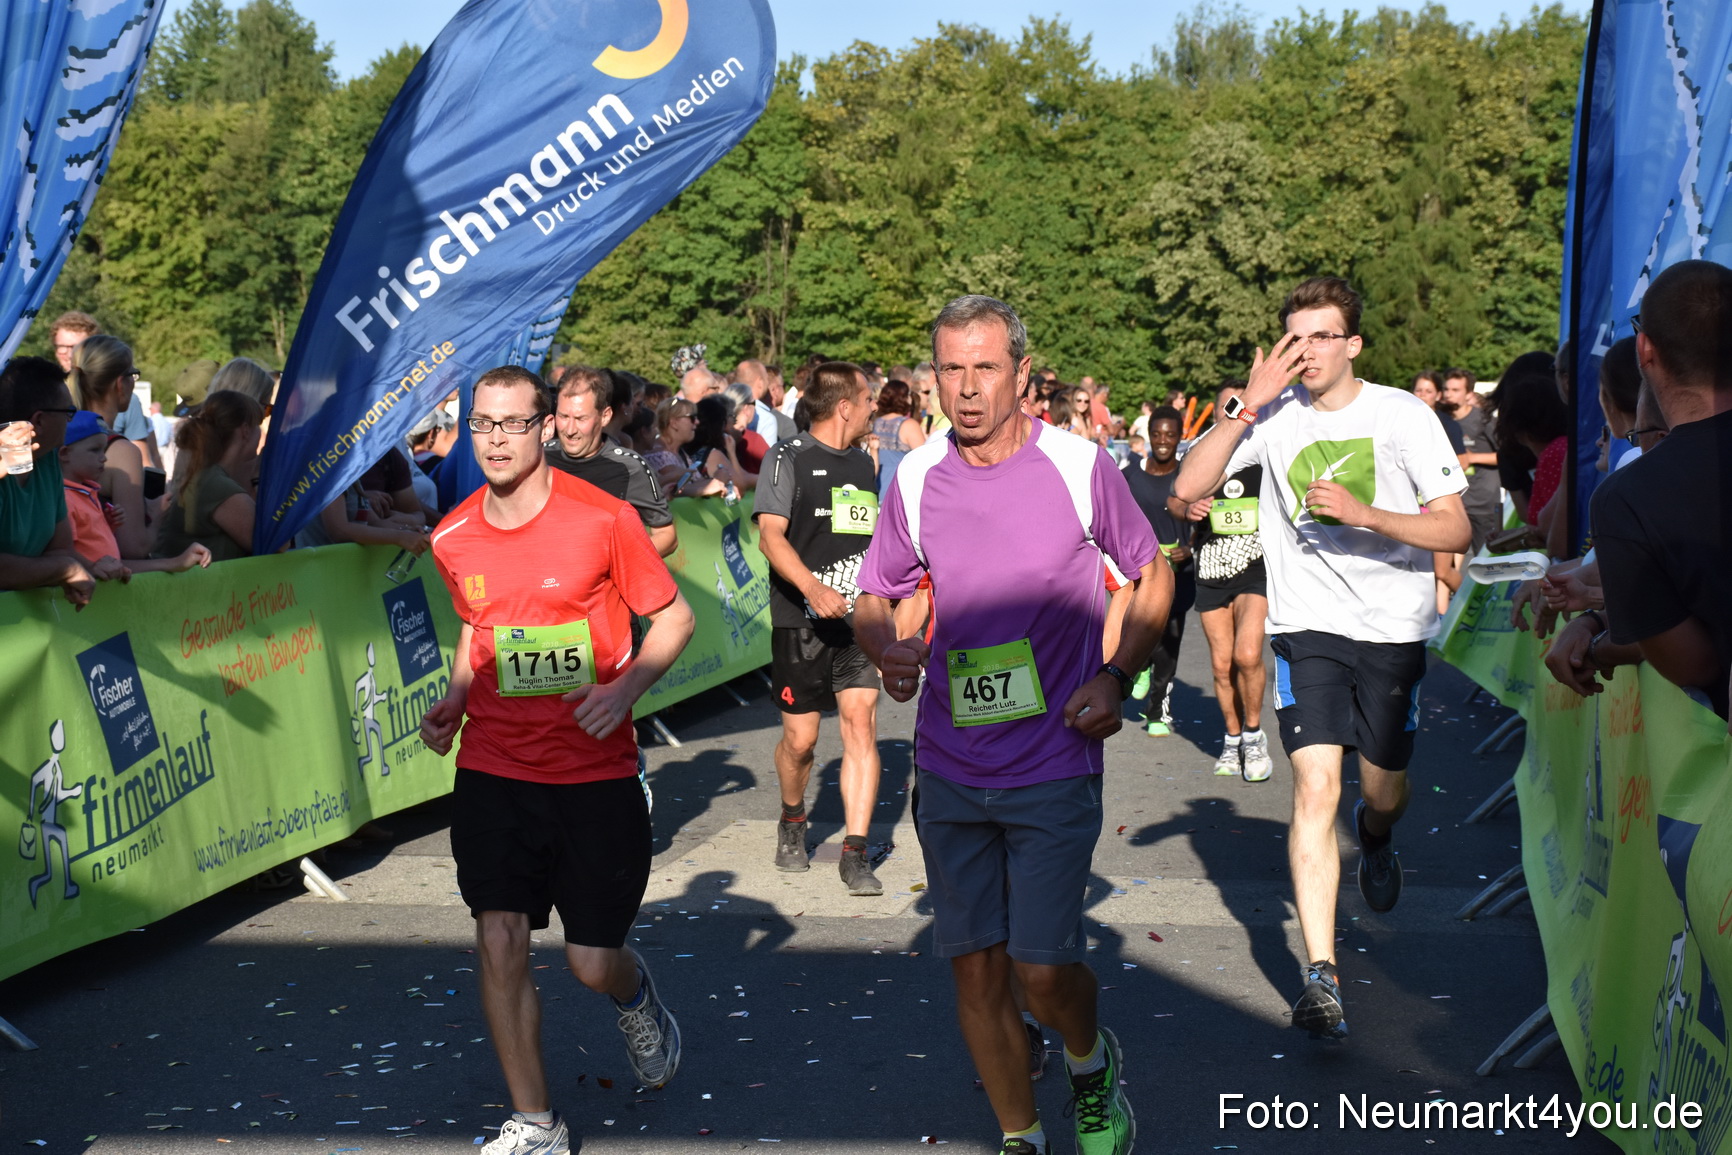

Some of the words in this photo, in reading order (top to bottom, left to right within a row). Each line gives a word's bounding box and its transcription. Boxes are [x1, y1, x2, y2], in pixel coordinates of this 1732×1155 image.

[531, 169, 606, 236] Druck
[604, 125, 654, 175] und
[651, 54, 745, 136] Medien
[335, 92, 635, 353] Frischmann
[272, 340, 456, 521] www.frischmann-net.de
[850, 505, 869, 522] 62
[1224, 511, 1243, 524] 83
[181, 590, 246, 659] Gesunde
[248, 582, 298, 625] Firmen
[397, 611, 425, 635] Fischer
[217, 643, 268, 698] laufen
[265, 609, 322, 675] länger!
[508, 647, 582, 677] 1715
[98, 676, 133, 708] Fischer
[518, 676, 543, 686] Hüglin
[544, 674, 575, 683] Thomas
[781, 686, 795, 705] 4
[963, 671, 1012, 704] 467
[109, 696, 137, 719] AUTOMOBILE
[387, 654, 452, 740] firmen
[968, 702, 998, 713] Reichert
[999, 699, 1017, 709] Lutz
[396, 738, 427, 766] neum
[82, 709, 215, 850] firmenlauf
[194, 780, 352, 873] www.firmenlauf-oberpfalz.de
[92, 822, 165, 883] neumarkt
